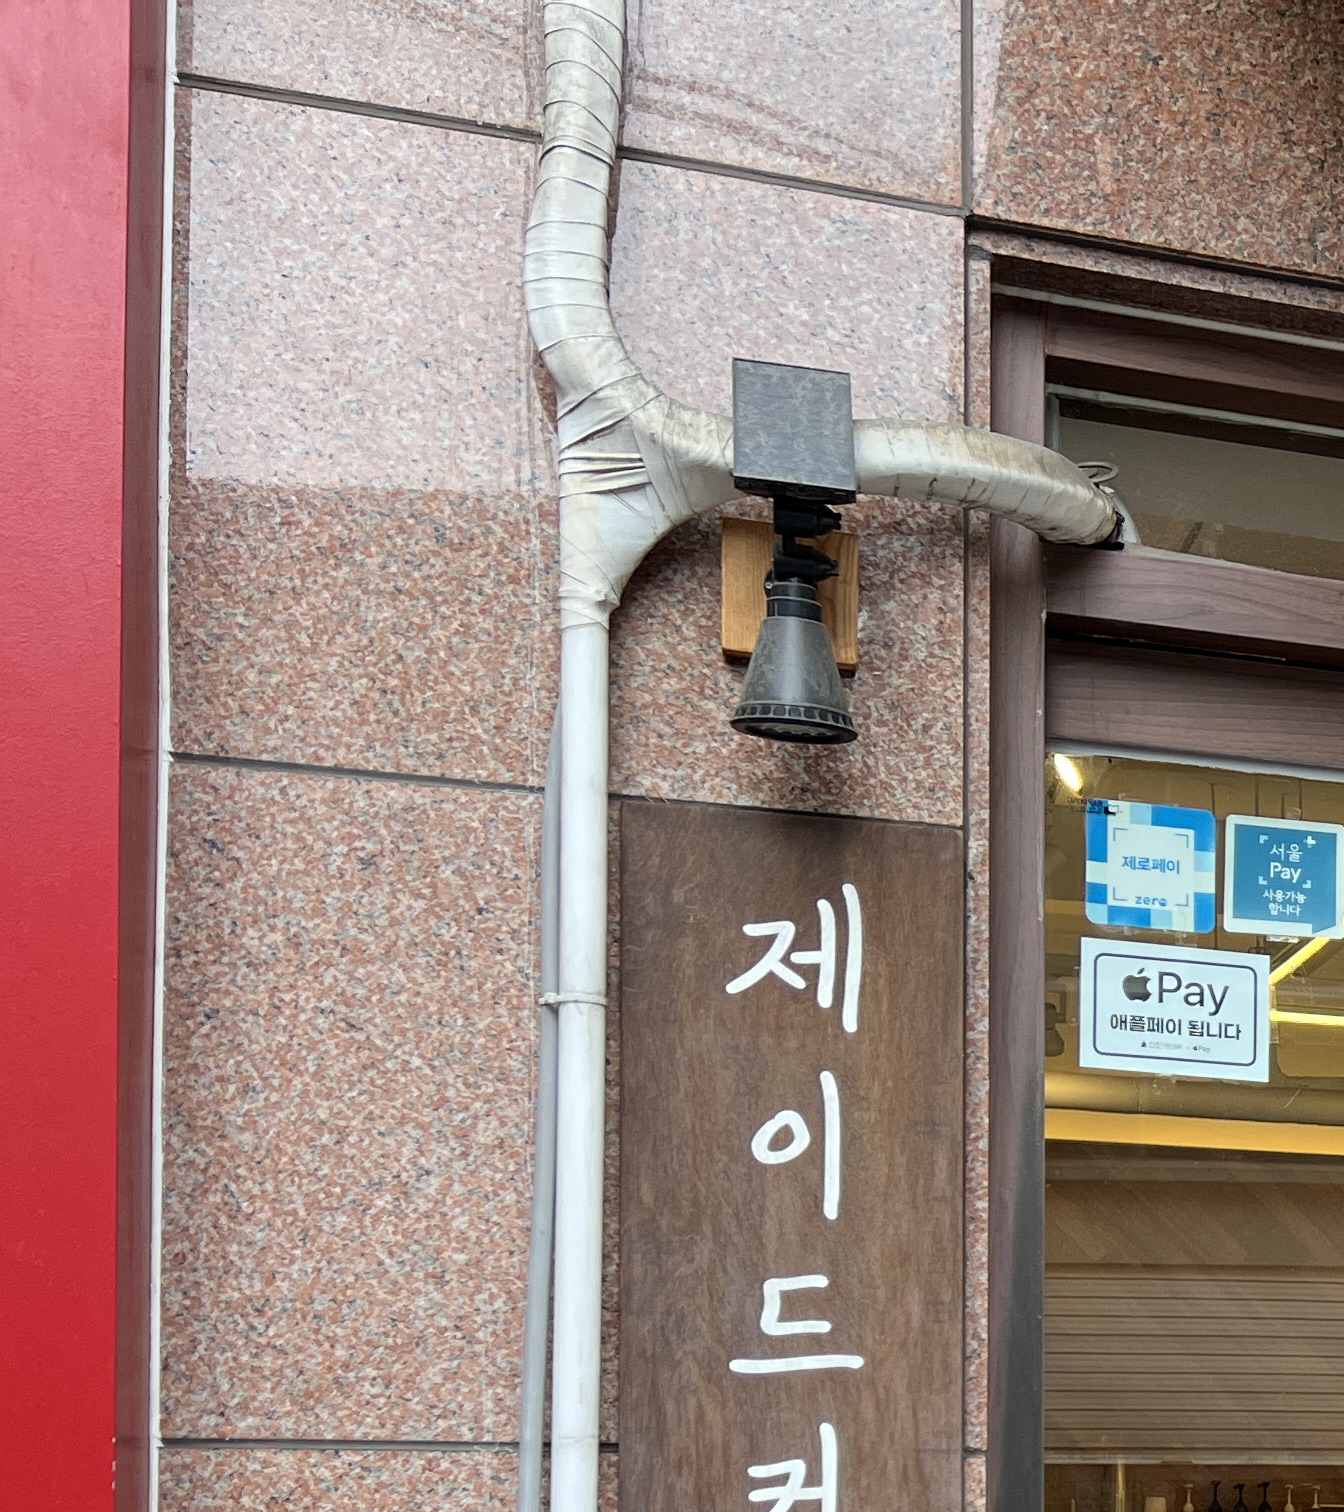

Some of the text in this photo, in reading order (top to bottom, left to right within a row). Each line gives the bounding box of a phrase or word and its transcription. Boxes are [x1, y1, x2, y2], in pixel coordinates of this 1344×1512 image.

[1270, 843, 1303, 863] 서울
[1121, 856, 1181, 875] 제로페이
[1270, 862, 1302, 884] Pay
[1135, 895, 1168, 907] zero
[1262, 889, 1308, 904] 사용가능
[1268, 903, 1302, 916] 합니다
[1158, 970, 1230, 1017] Pay
[1110, 1013, 1242, 1041] 애플페이 됩니다
